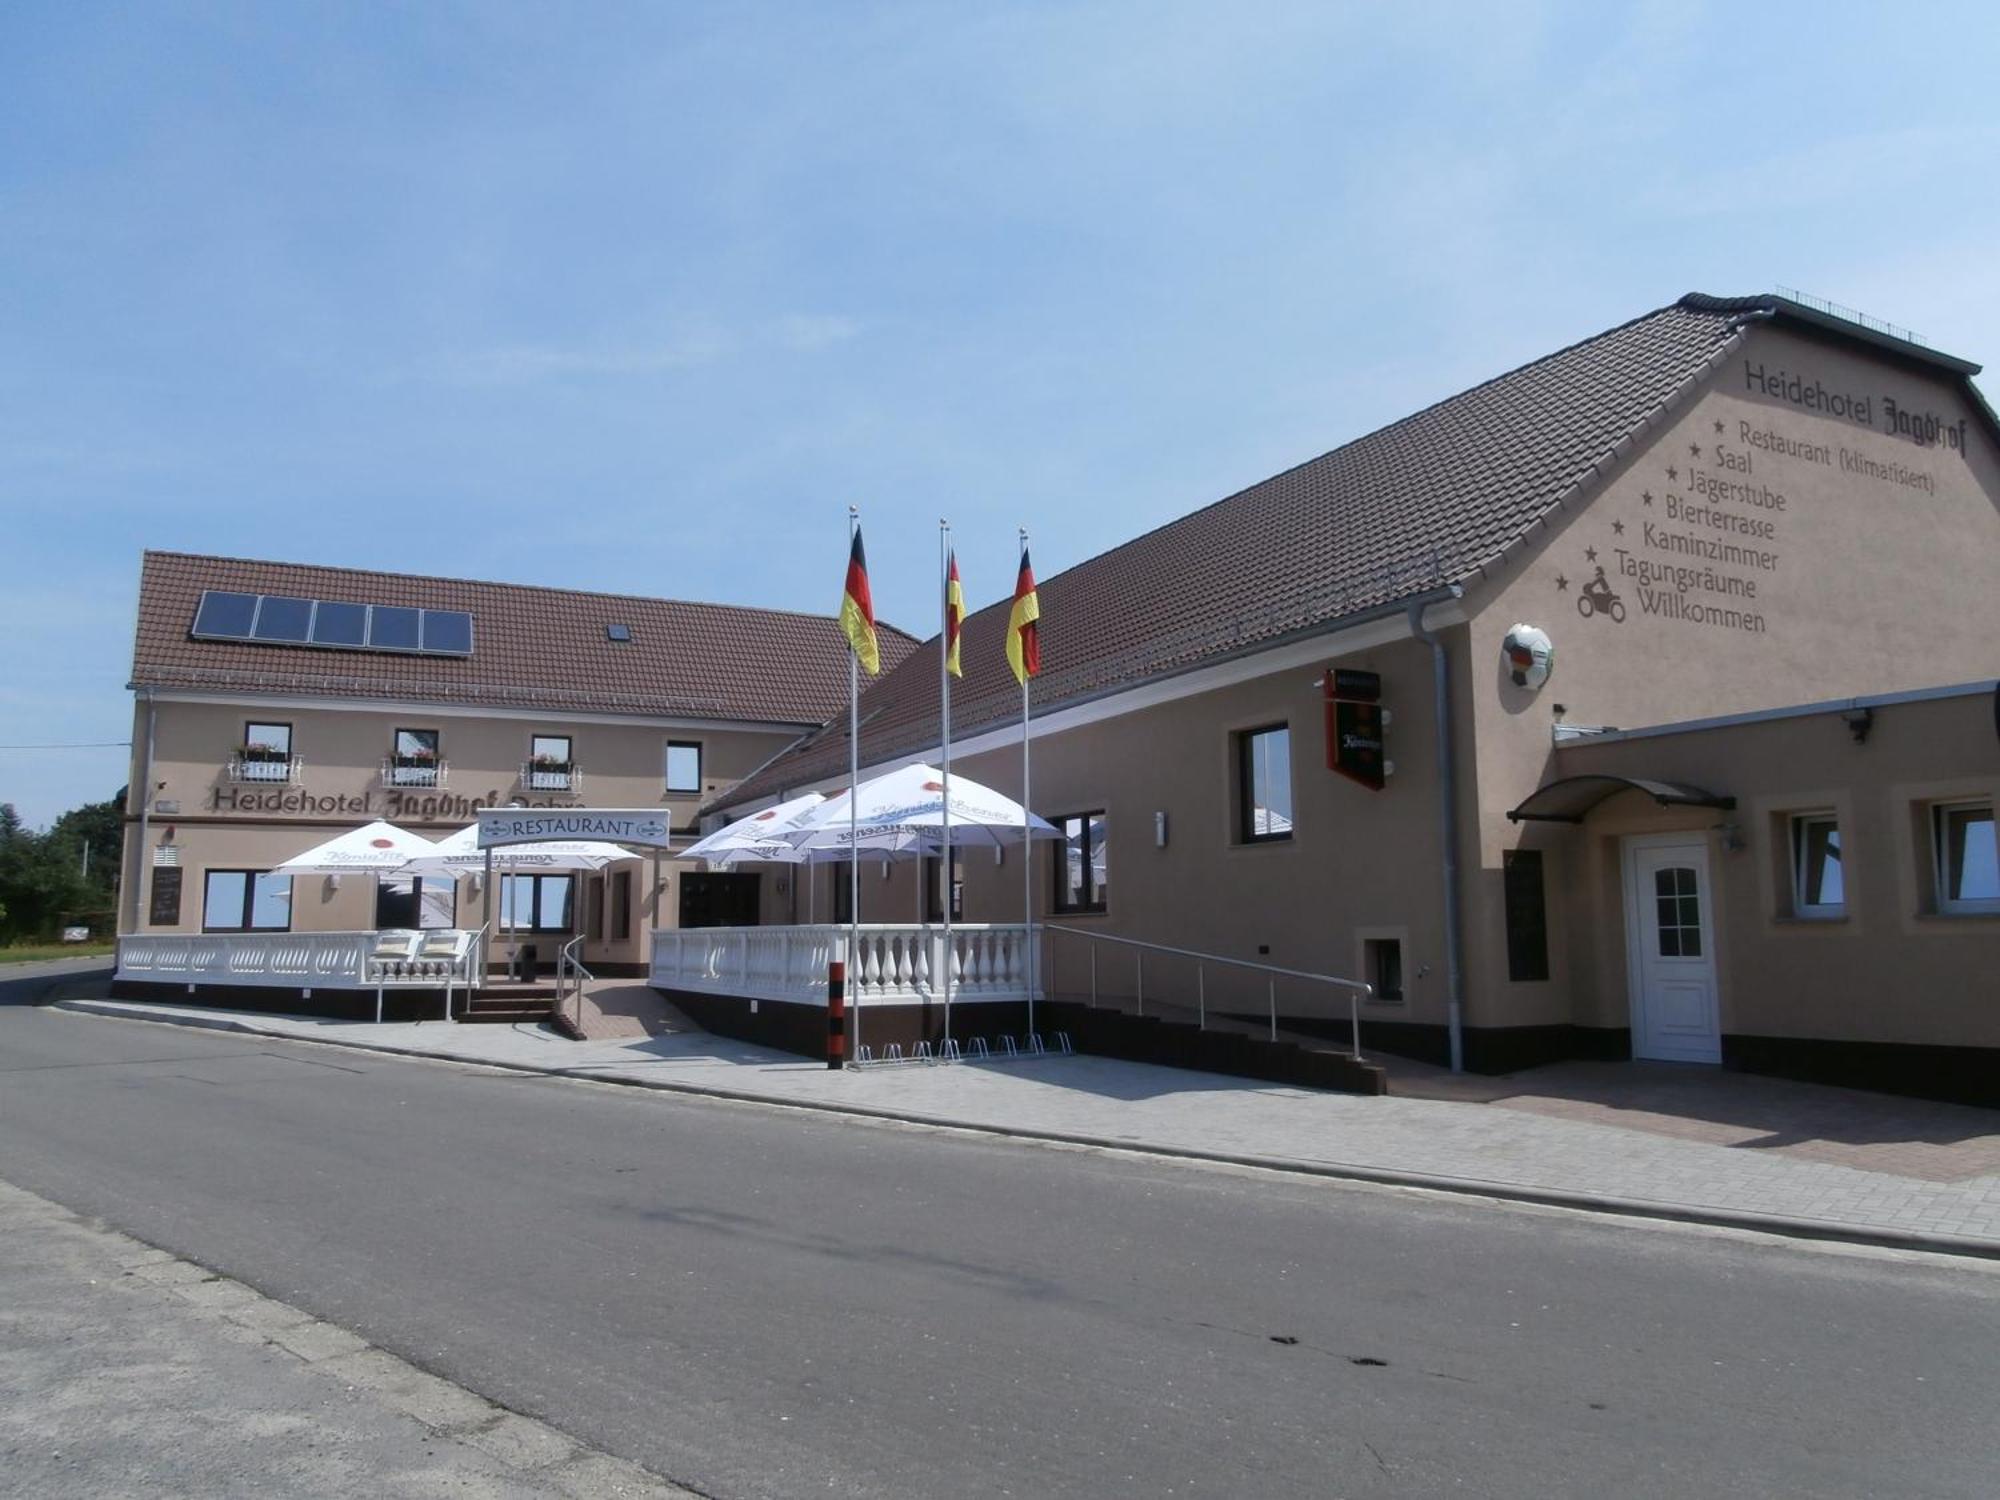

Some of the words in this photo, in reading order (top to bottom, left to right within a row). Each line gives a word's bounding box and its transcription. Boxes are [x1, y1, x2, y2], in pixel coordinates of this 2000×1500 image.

[1744, 360, 1873, 425] Heidehotel
[1884, 396, 1967, 458] Jagdhof
[1716, 444, 1752, 475] Saal
[1739, 419, 1831, 466] Restaurant
[1839, 449, 1935, 496] (klimatisiert)
[1687, 467, 1786, 511] Jägerstube
[1666, 494, 1775, 540] Bierterrasse
[1643, 521, 1779, 571] Kaminzimmer
[1614, 548, 1756, 598] Tagungsräume
[1637, 587, 1766, 632] Willkommen
[213, 787, 370, 813] Heidehotel
[385, 789, 499, 820] Jagdhof
[512, 818, 635, 836] RESTAURANT
